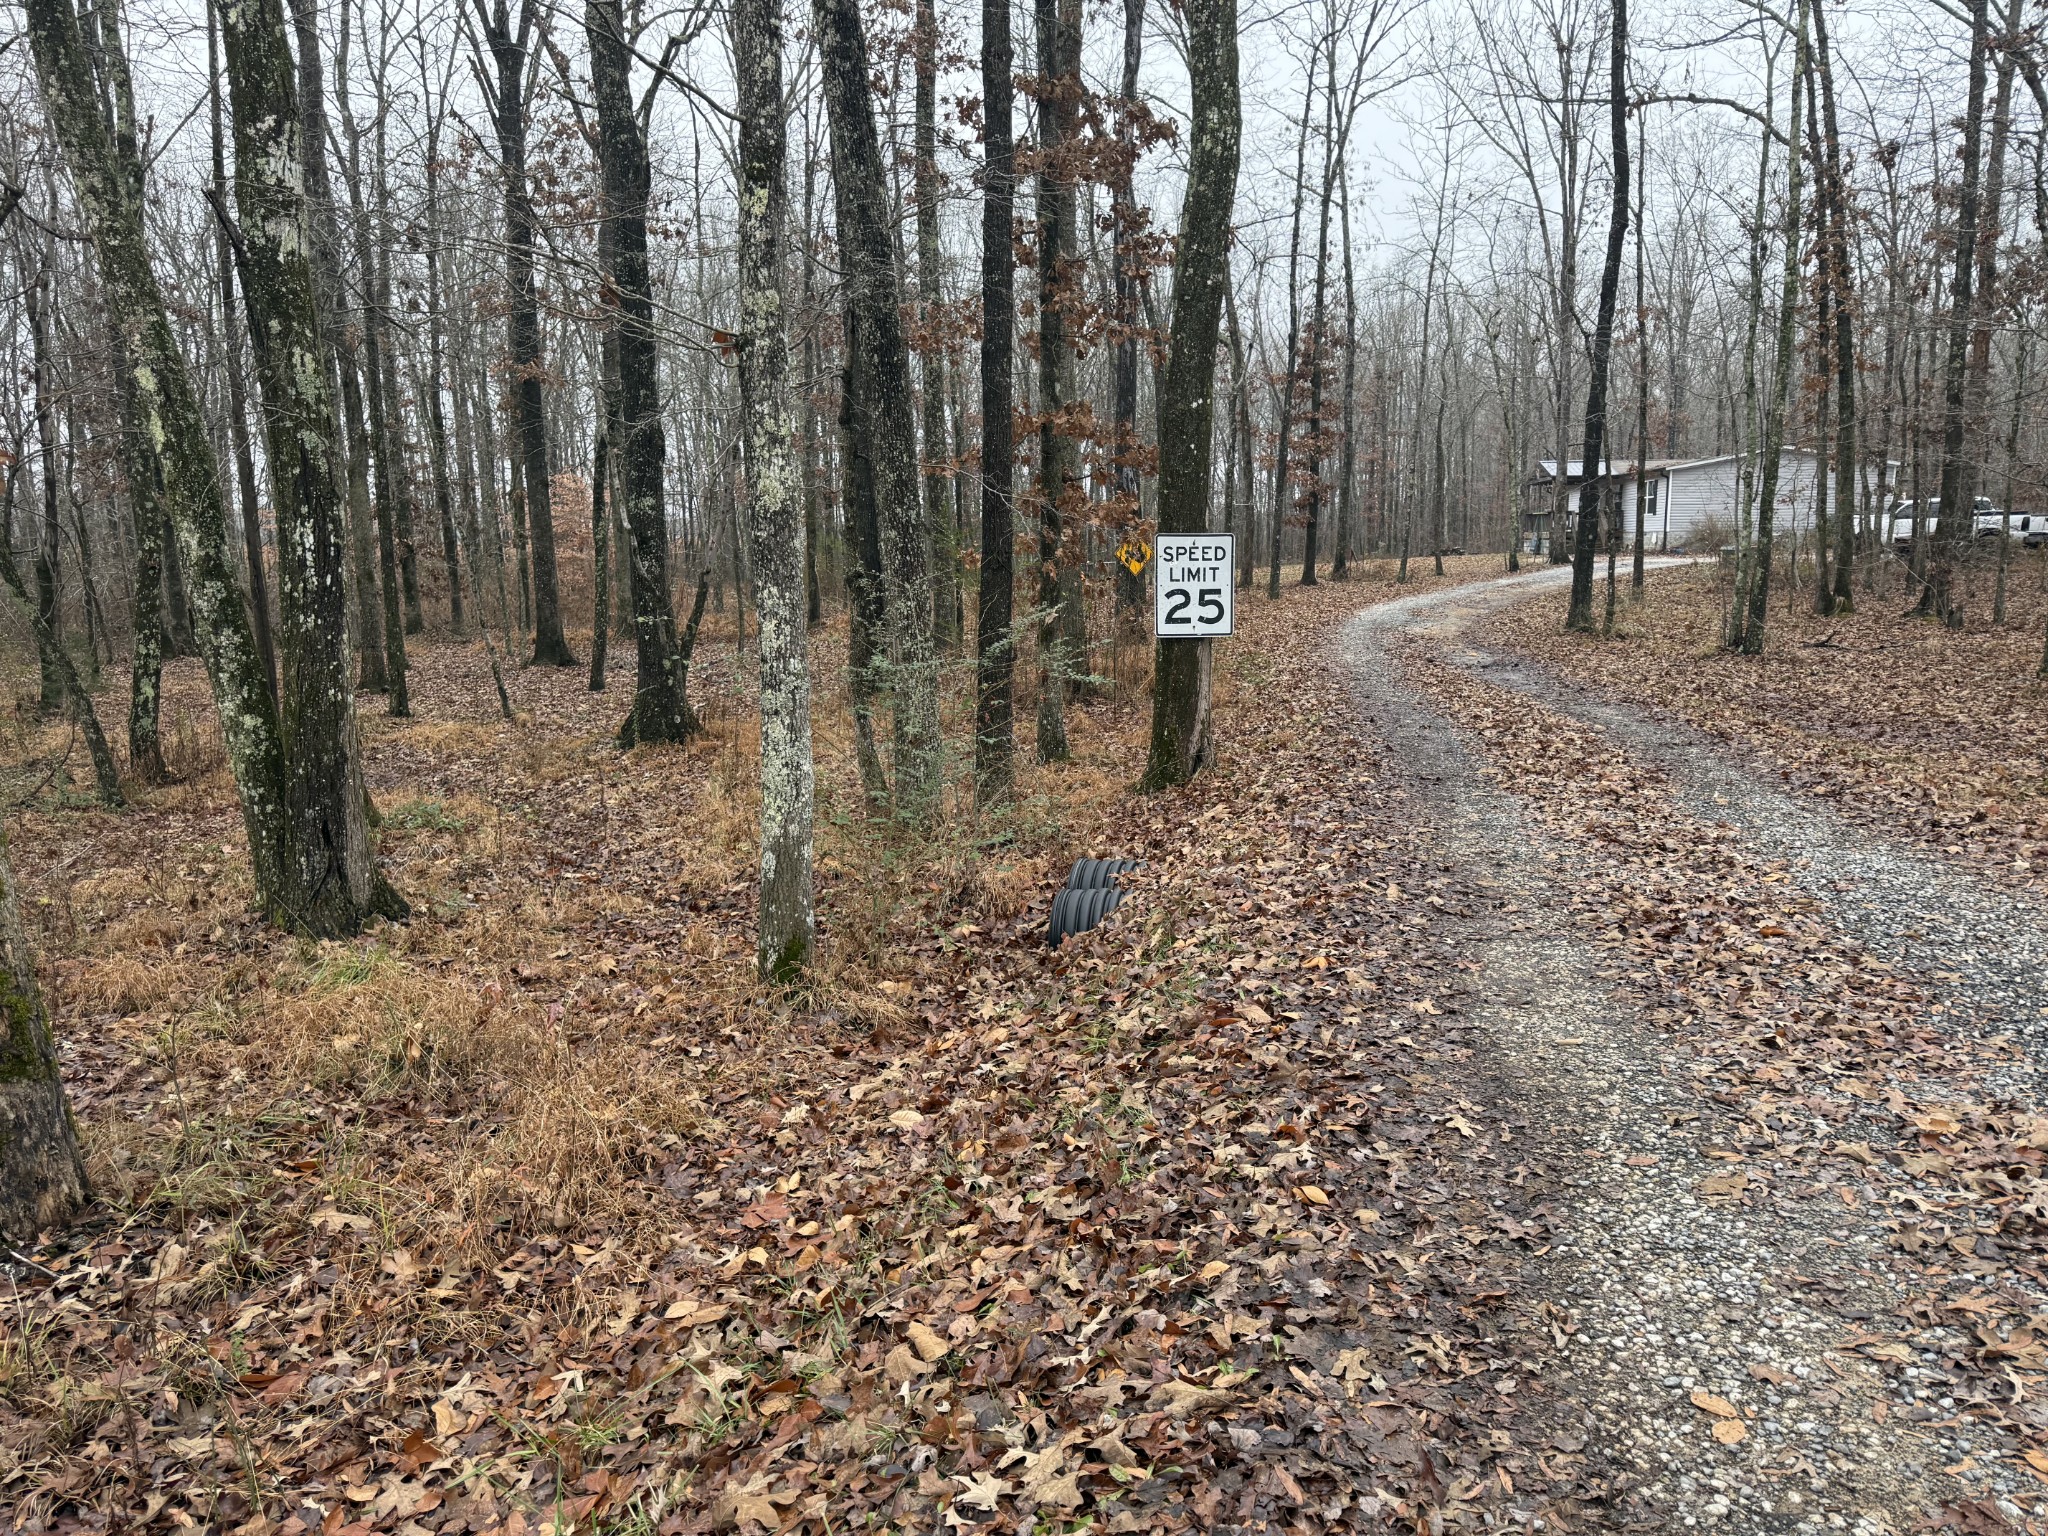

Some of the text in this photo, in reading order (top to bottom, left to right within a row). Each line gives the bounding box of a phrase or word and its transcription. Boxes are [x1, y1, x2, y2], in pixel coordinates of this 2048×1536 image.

[1163, 546, 1226, 562] SPEED
[1169, 567, 1220, 582] LIMIT
[1164, 588, 1225, 624] 25
